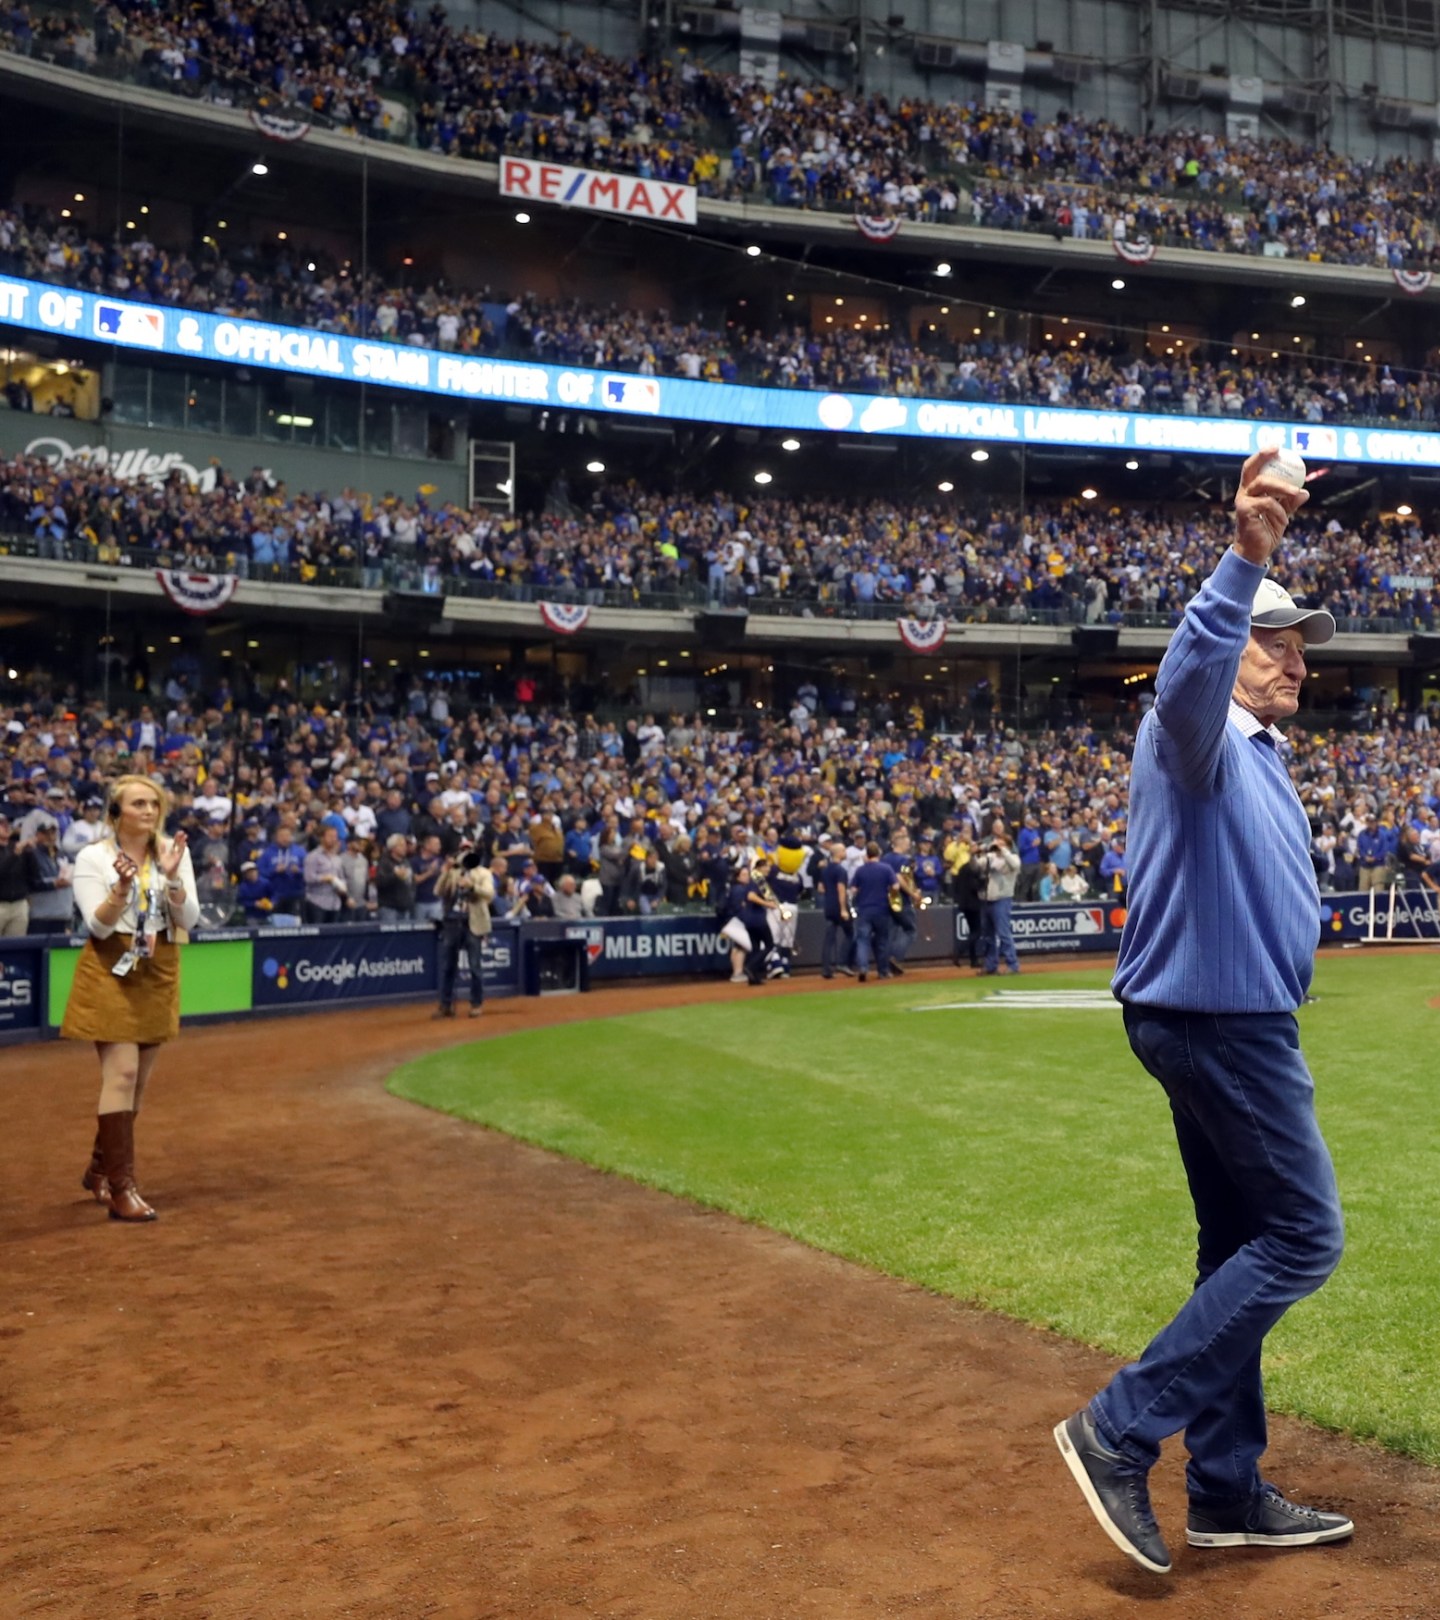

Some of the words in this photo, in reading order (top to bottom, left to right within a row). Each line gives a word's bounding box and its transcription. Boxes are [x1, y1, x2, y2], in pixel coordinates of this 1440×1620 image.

[505, 160, 686, 219] RE/MAX
[39, 292, 83, 329] OF
[177, 318, 203, 351] &
[214, 323, 343, 373] OFFICIAL
[352, 345, 429, 386] STAIN
[438, 358, 549, 401] FIGHTER
[557, 372, 594, 404] OF
[917, 403, 1018, 438] OFFICIAL
[605, 934, 651, 959] MLB
[655, 933, 733, 957] NETWO
[1036, 939, 1080, 950] Experience
[296, 958, 355, 985] Google
[357, 956, 425, 977] Assistant
